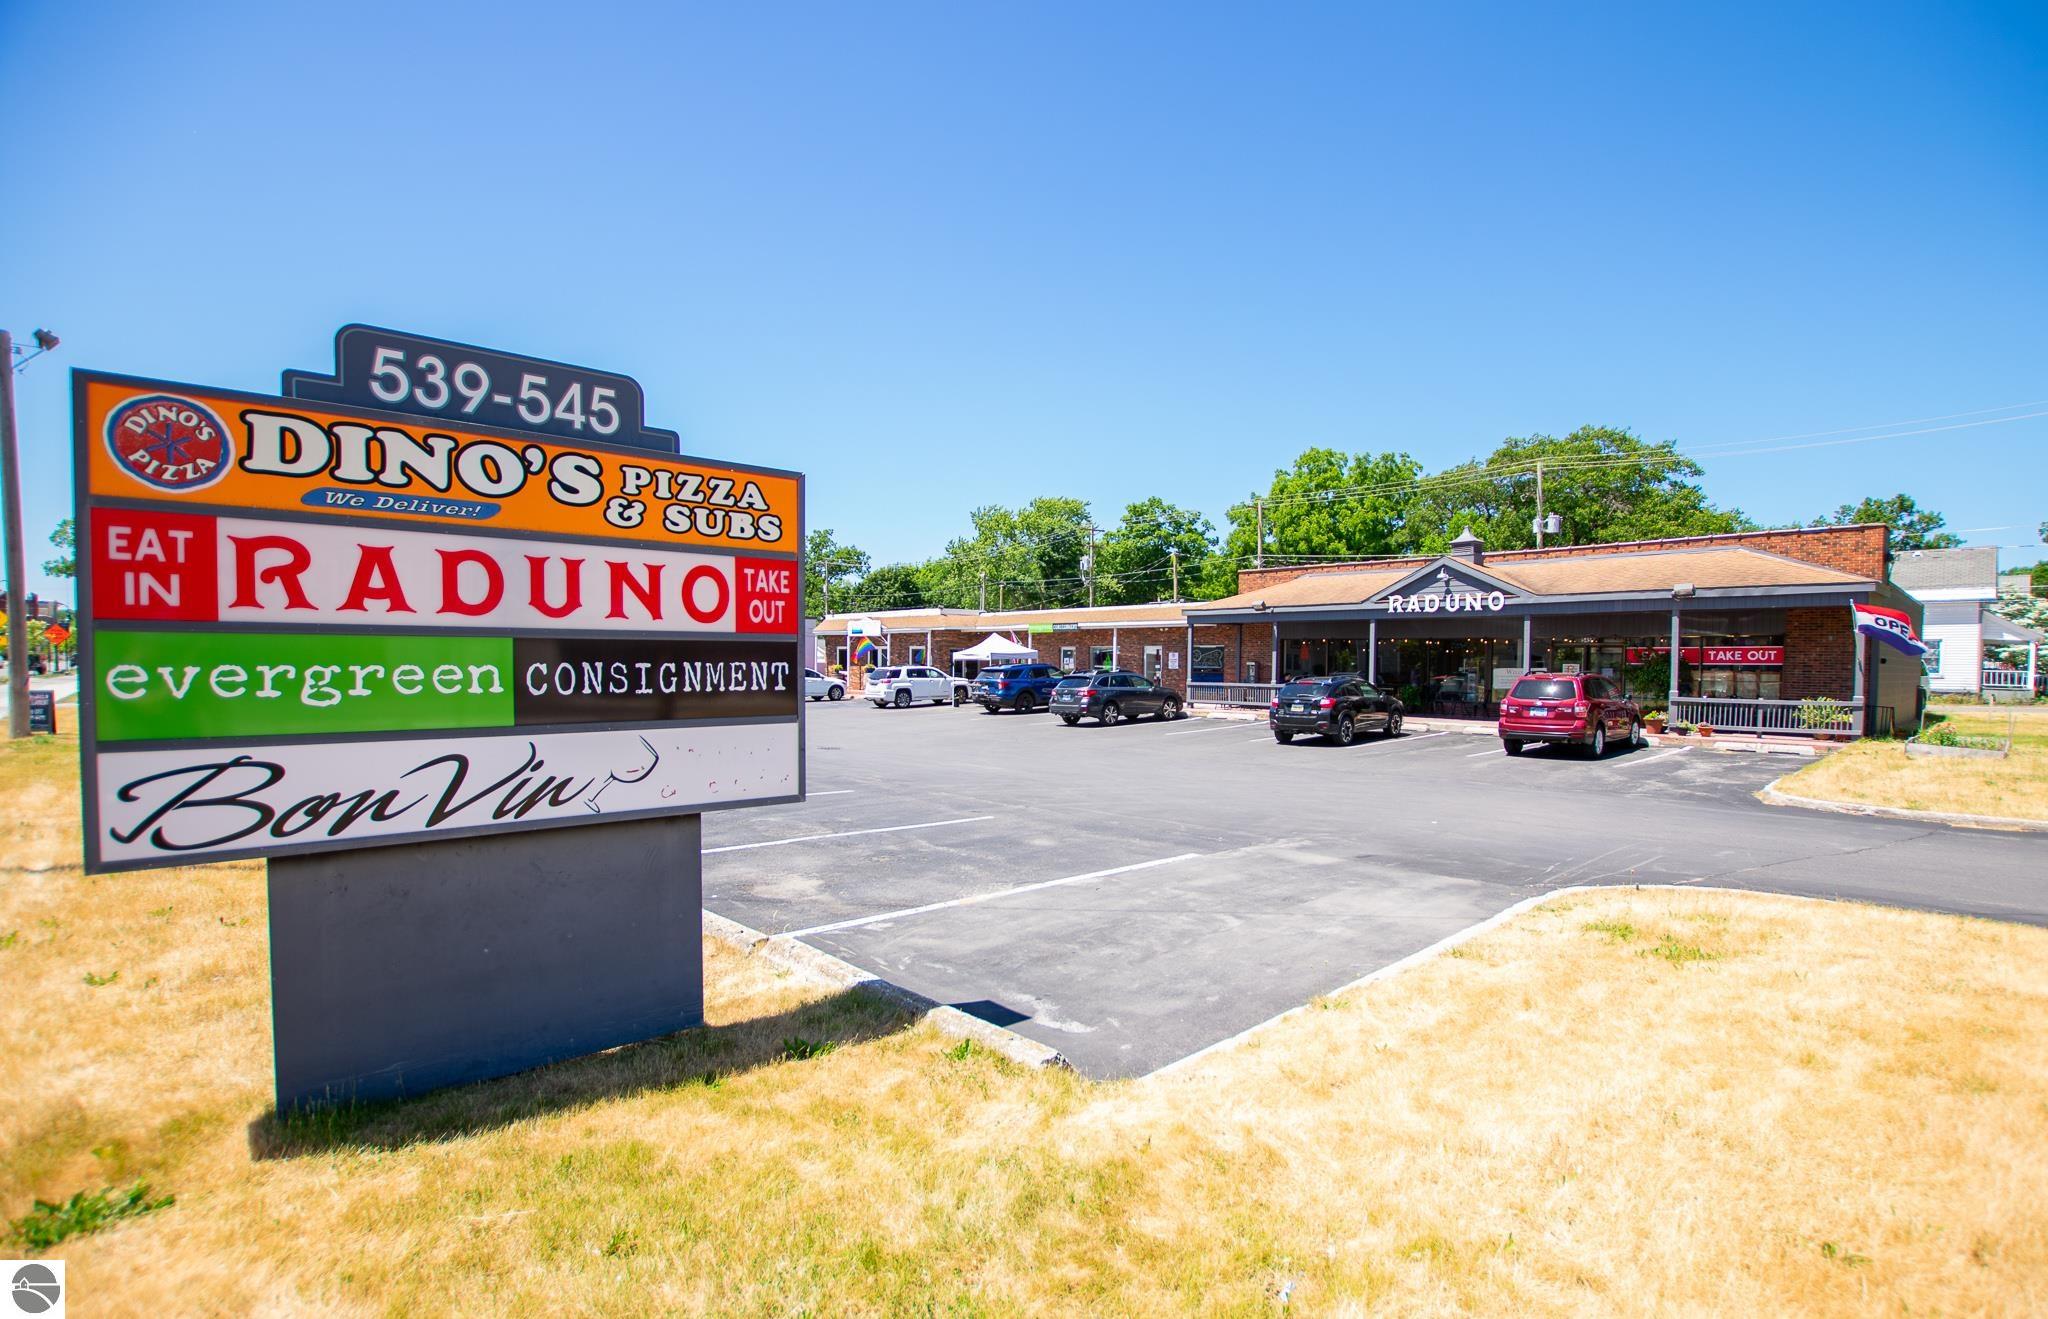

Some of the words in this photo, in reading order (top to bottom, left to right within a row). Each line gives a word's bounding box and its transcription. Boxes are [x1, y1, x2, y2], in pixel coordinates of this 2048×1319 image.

[368, 345, 620, 435] 539-545
[123, 405, 216, 443] DINO'S
[127, 448, 217, 481] PIZZA
[239, 409, 604, 507] DINO'S
[619, 465, 769, 511] PIZZA
[325, 491, 365, 507] We
[372, 496, 482, 517] Deliver!
[604, 497, 646, 528] &
[663, 504, 783, 542] SUBS
[108, 526, 194, 564] EAT
[124, 571, 181, 606] IN
[227, 534, 730, 624] RADUNO
[744, 568, 790, 595] TAKE
[749, 600, 786, 624] OUT
[1387, 591, 1505, 613] RADUNO
[1875, 617, 1912, 638] OPE
[1708, 651, 1742, 661] TAKE
[1747, 650, 1777, 661] OUT
[106, 664, 504, 708] evergreen
[526, 661, 790, 696] CONSIGNMENT
[110, 755, 429, 851] Bon
[400, 741, 596, 829] Vin
